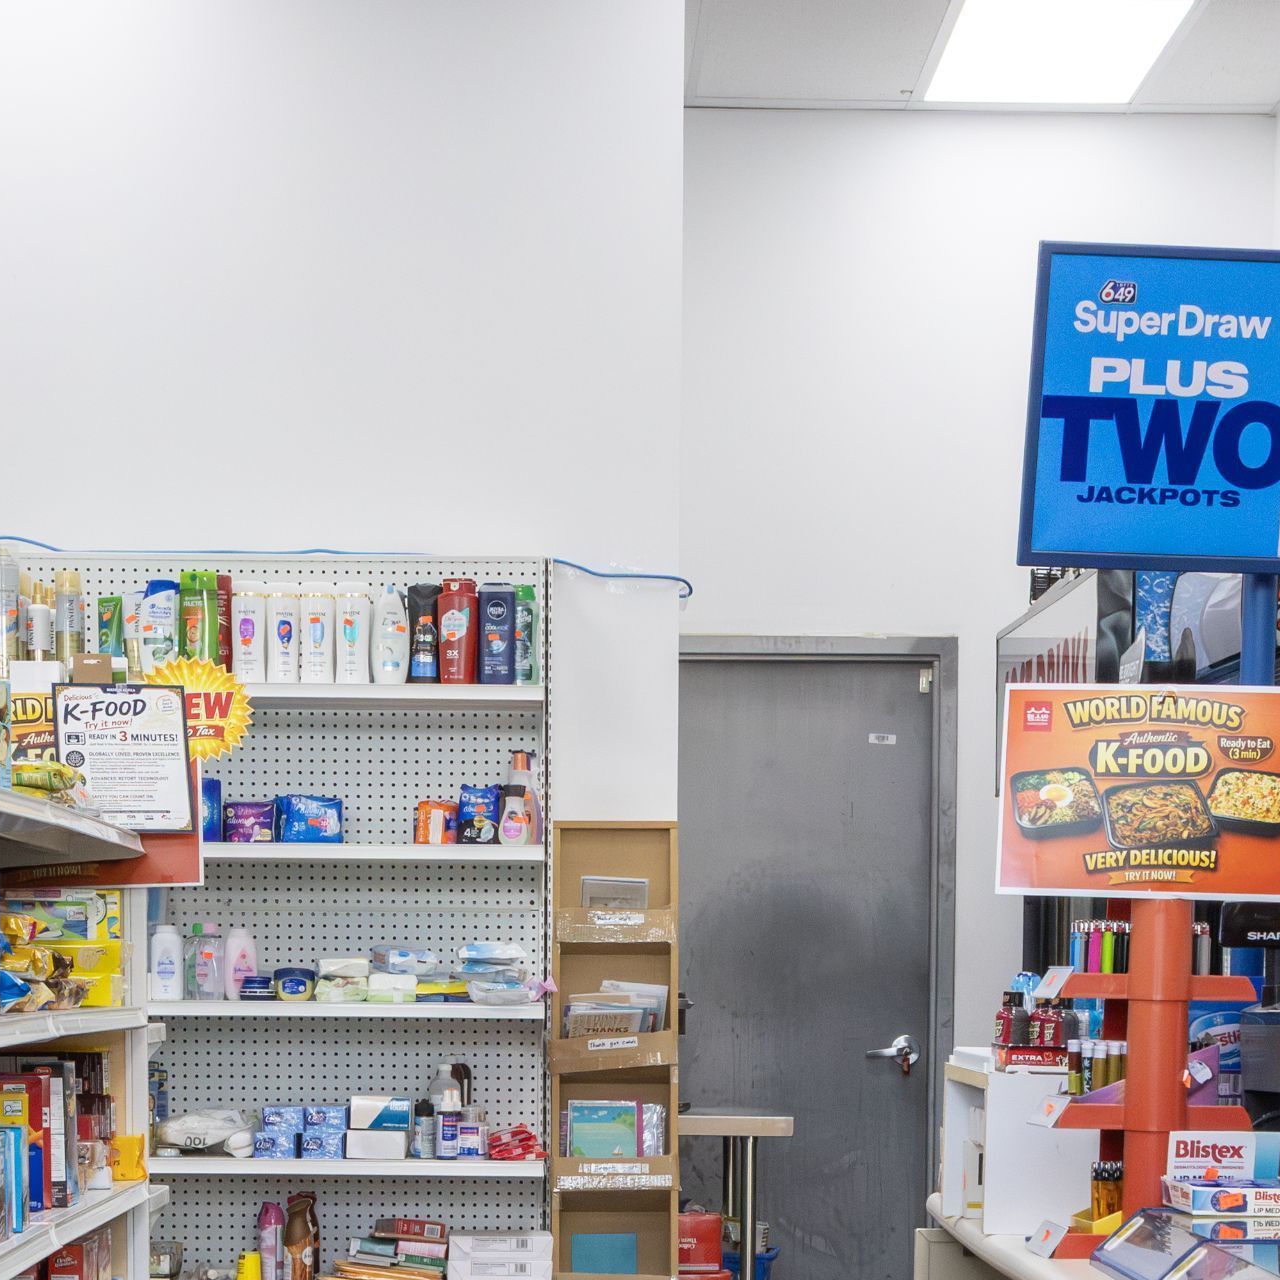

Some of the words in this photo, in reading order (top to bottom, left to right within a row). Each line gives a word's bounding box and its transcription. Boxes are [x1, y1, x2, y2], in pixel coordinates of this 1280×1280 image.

[1089, 357, 1249, 399] PLUS
[1076, 486, 1241, 507] JACKPOTS
[64, 694, 92, 702] Delicious
[63, 699, 146, 725] K-FOOD
[187, 691, 234, 720] EW
[1068, 696, 1146, 728] WORLD
[1149, 698, 1244, 728] FAMOUS
[84, 721, 98, 730] Try
[112, 718, 133, 726] now!
[196, 725, 215, 736] Tax
[119, 731, 127, 742] 3
[131, 734, 178, 742] MINUTES!
[1122, 732, 1178, 745] Authentic
[1220, 737, 1246, 749] Ready
[1248, 738, 1255, 748] to
[1257, 740, 1271, 748] Eat
[1096, 741, 1208, 773] K-FOOD
[1229, 749, 1240, 759] (3
[1241, 749, 1261, 759] min)
[1085, 852, 1125, 869] VERY
[1129, 850, 1217, 869] DELICIOUS!
[1124, 871, 1140, 881] TRY
[1142, 871, 1149, 880] IT
[1151, 870, 1176, 880] NOW!
[1011, 1054, 1042, 1062] EXTRA
[1175, 1140, 1246, 1164] Blistex
